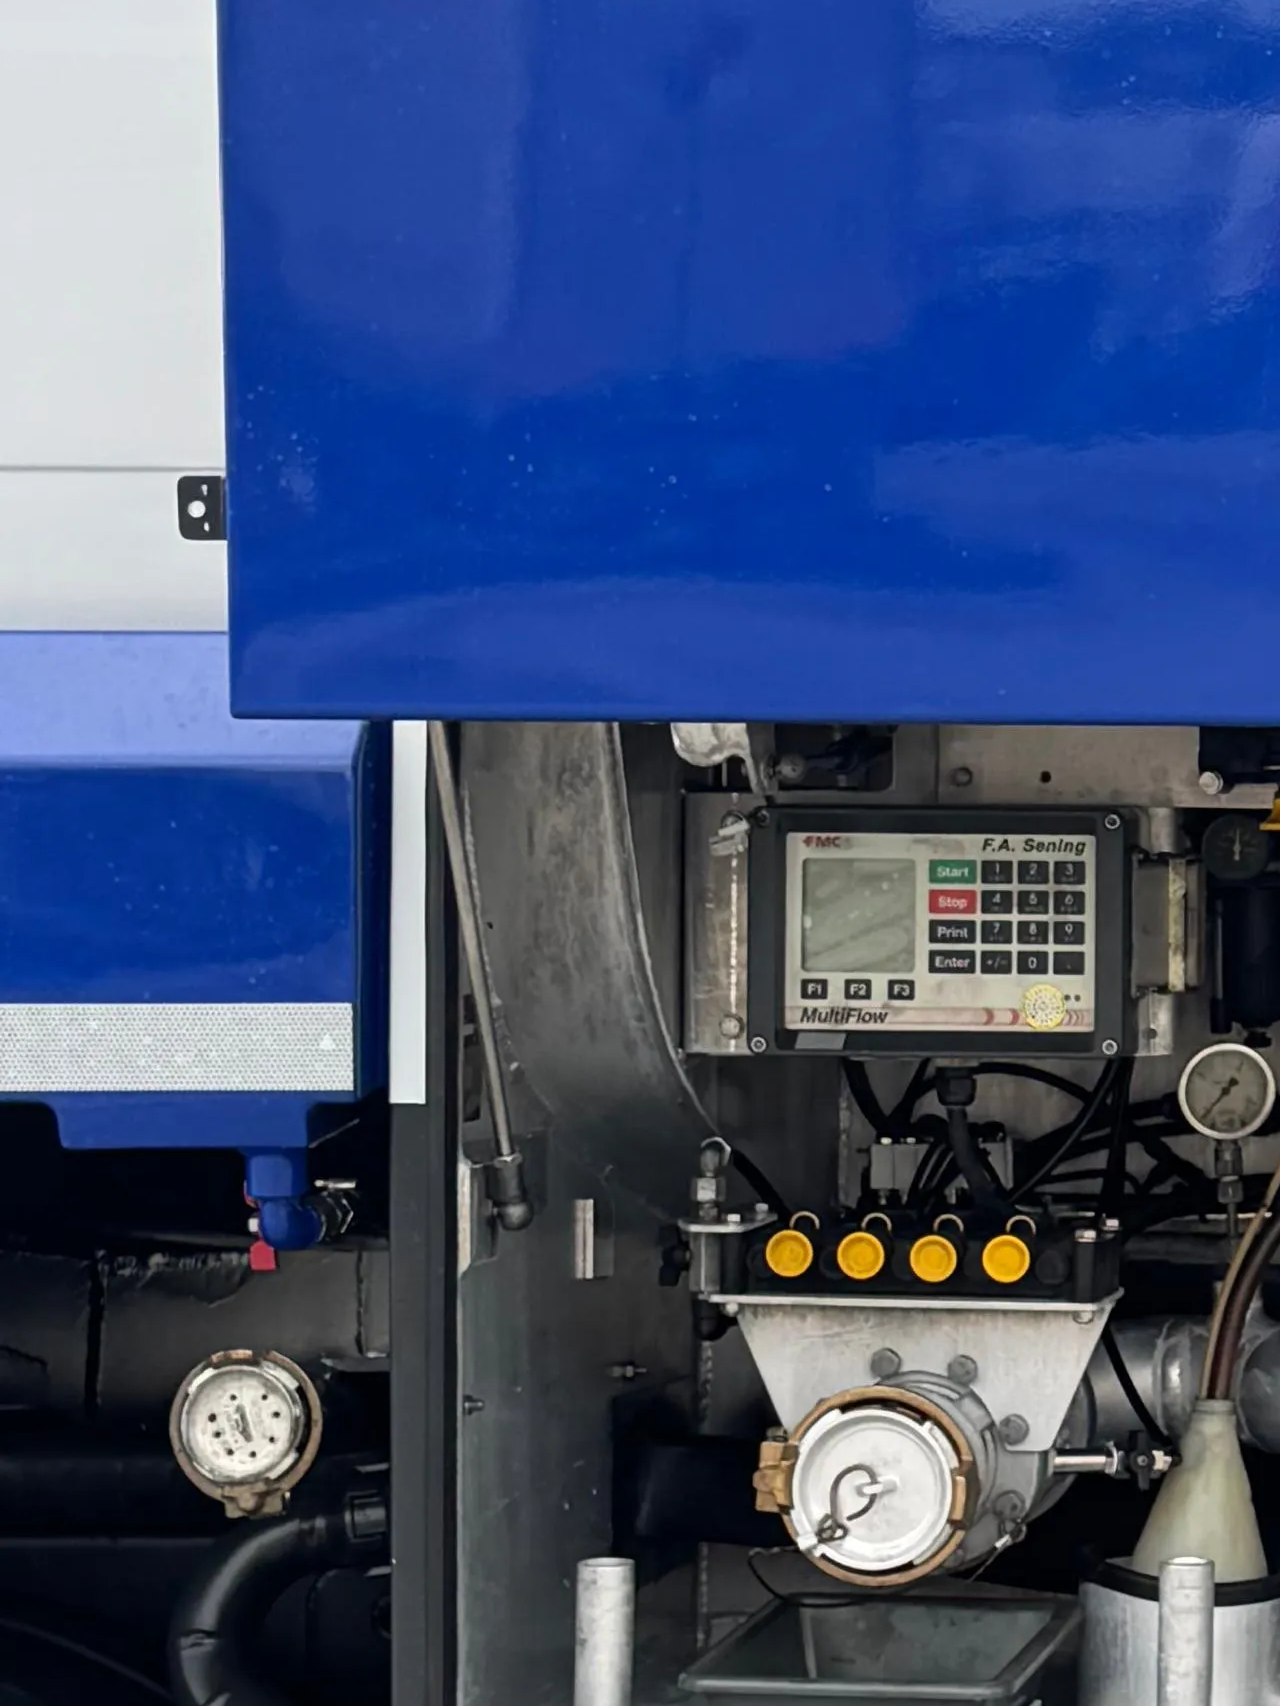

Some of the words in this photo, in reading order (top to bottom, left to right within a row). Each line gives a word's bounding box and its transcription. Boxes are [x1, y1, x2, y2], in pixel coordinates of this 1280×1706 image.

[982, 838, 1015, 852] F.A.
[1022, 838, 1087, 856] Sening
[937, 865, 969, 878] Start
[1028, 863, 1038, 875] 2
[1064, 863, 1074, 875] 3
[938, 896, 967, 909] Stop
[991, 893, 1001, 904] 4
[936, 925, 968, 938] Print
[1064, 923, 1074, 935] 9
[934, 955, 971, 968] Enter
[806, 982, 822, 995] F1
[850, 983, 867, 996] F2
[893, 984, 911, 997] F3
[799, 1006, 889, 1024] MultiFlow
